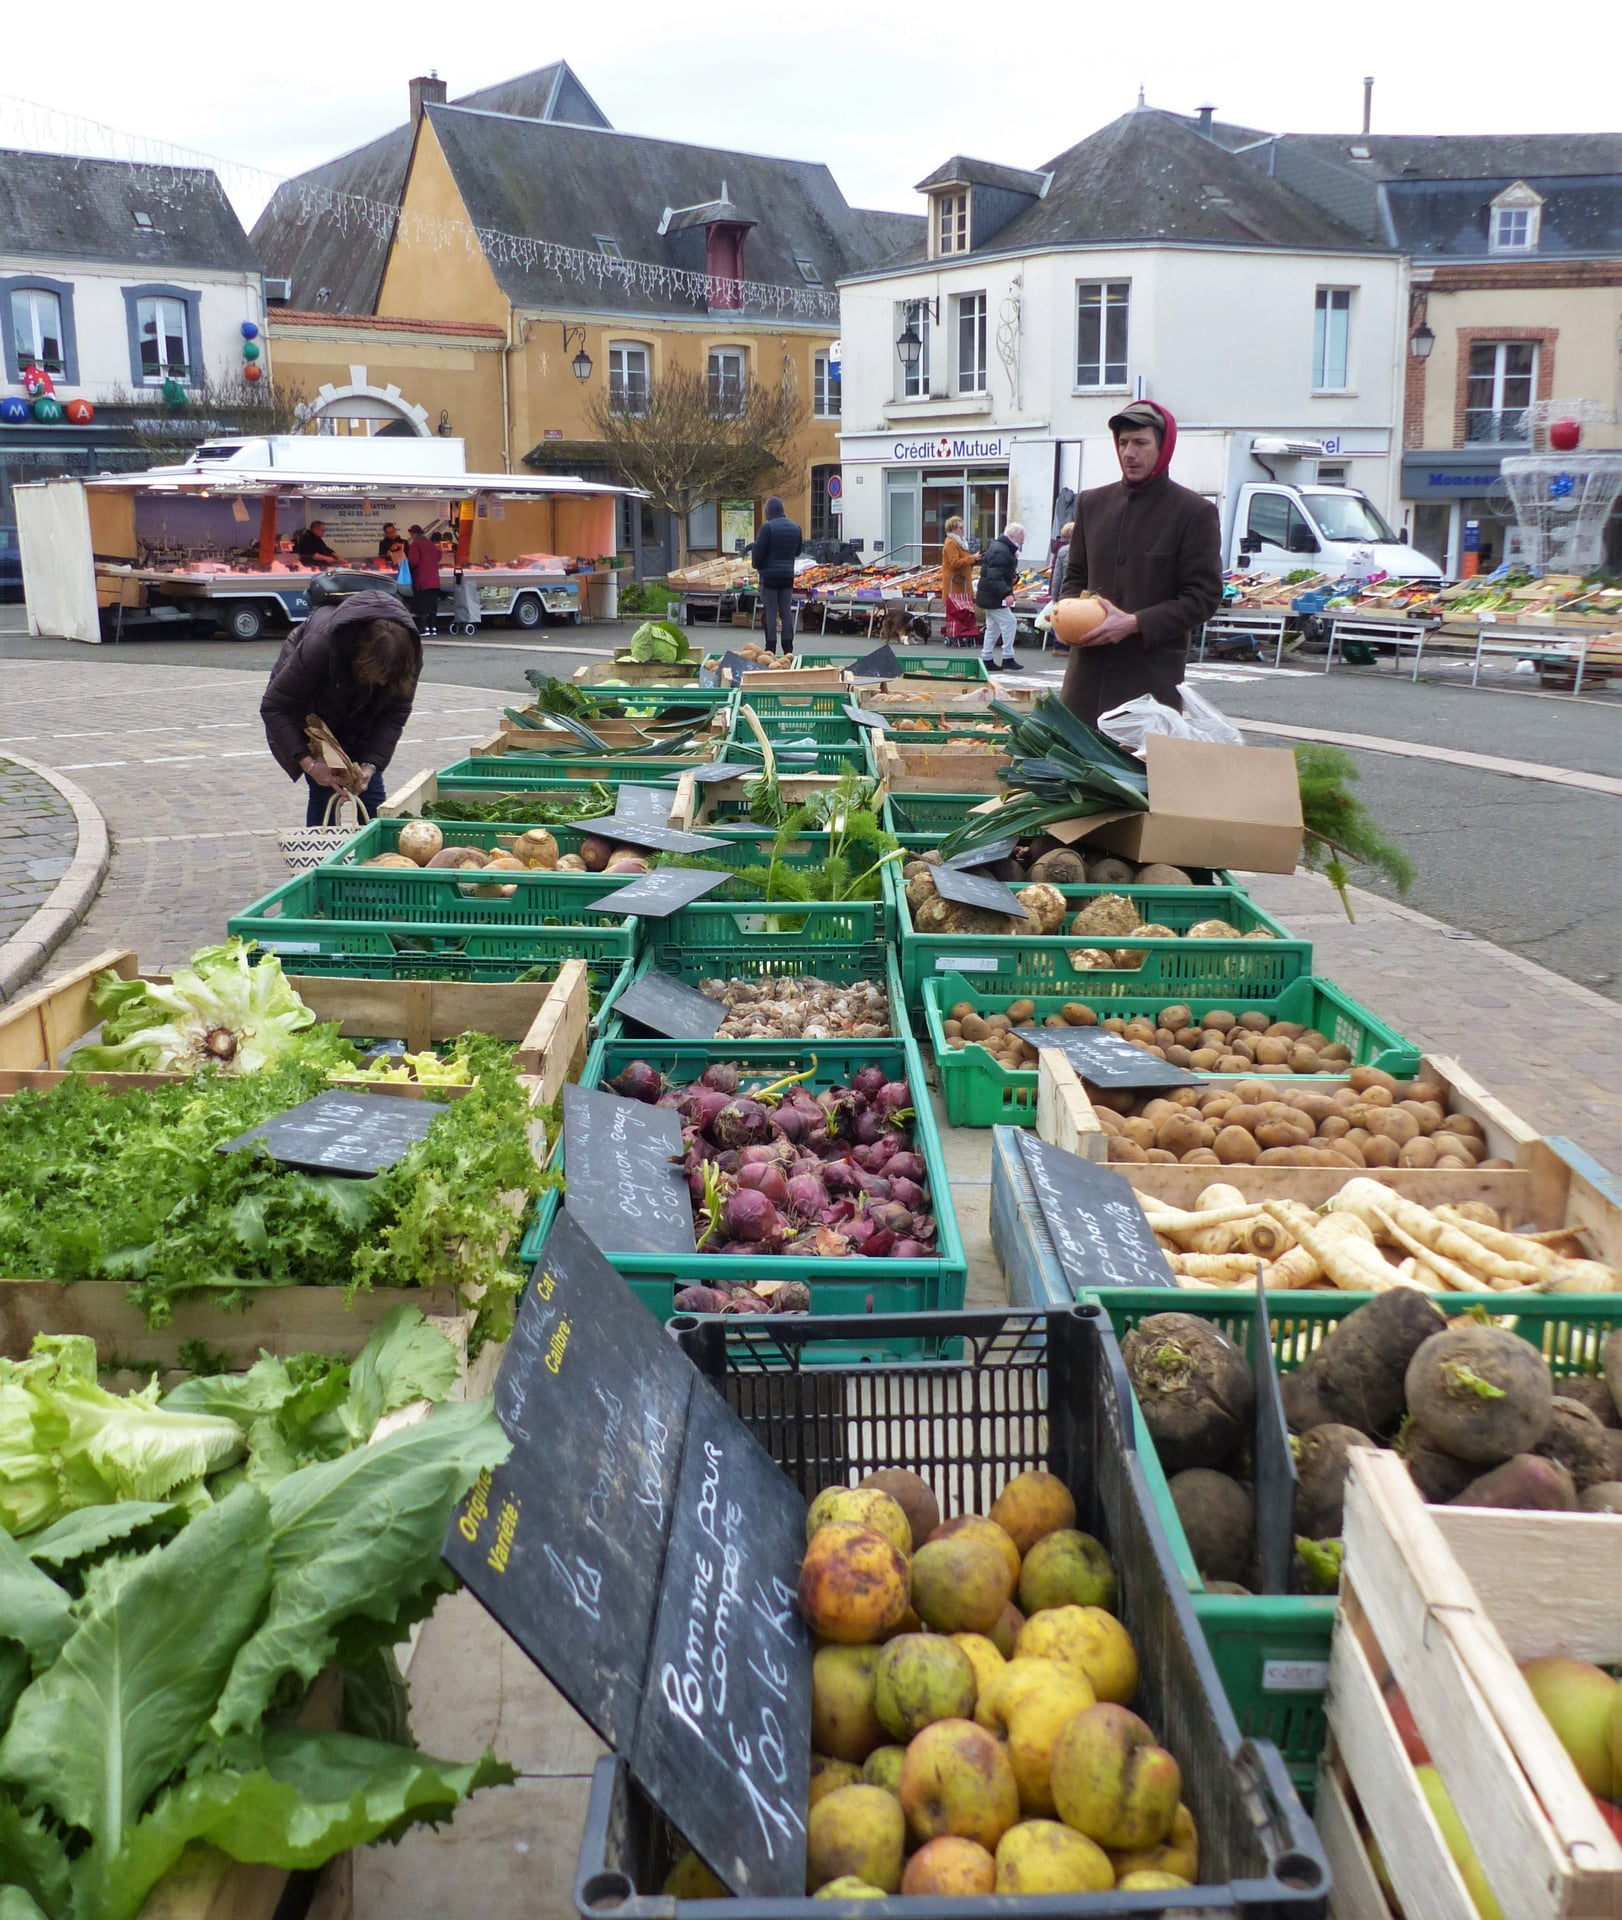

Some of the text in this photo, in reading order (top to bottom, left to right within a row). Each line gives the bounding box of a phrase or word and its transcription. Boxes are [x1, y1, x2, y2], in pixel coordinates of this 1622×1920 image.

[894, 438, 1002, 459] Crédit Mutuel
[1321, 437, 1340, 453] el
[544, 1317, 571, 1375] Calibre
